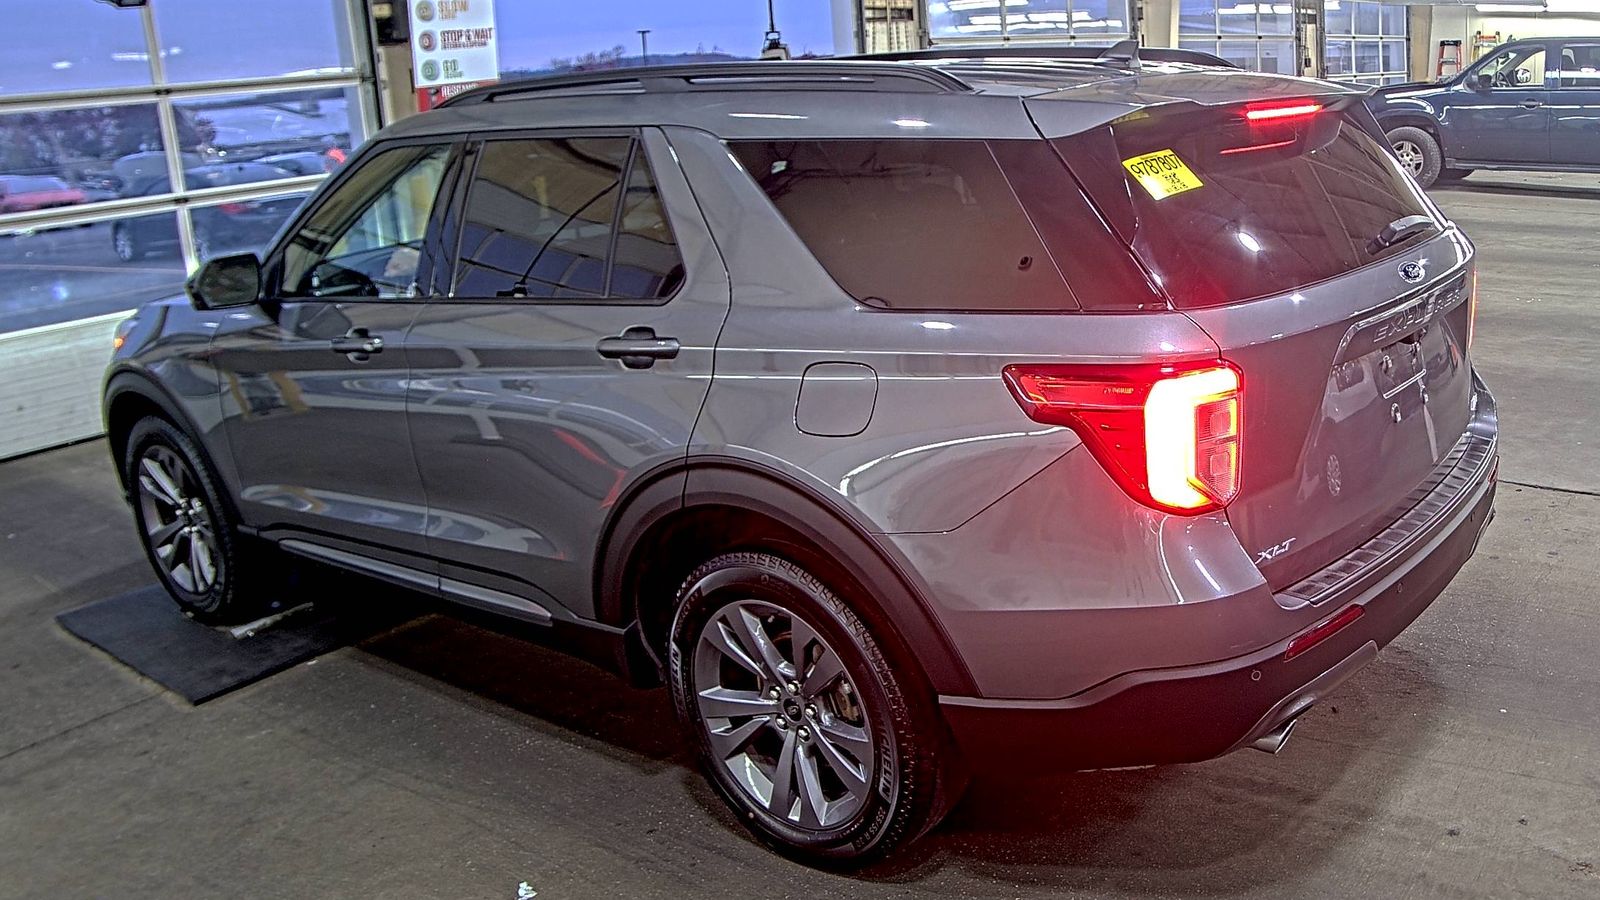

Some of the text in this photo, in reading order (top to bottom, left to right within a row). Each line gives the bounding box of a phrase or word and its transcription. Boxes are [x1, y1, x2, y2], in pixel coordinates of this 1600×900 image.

[440, 29, 463, 42] STOP
[473, 28, 493, 40] WAIT
[1130, 154, 1182, 176] 9787807
[1255, 537, 1297, 565] XLT
